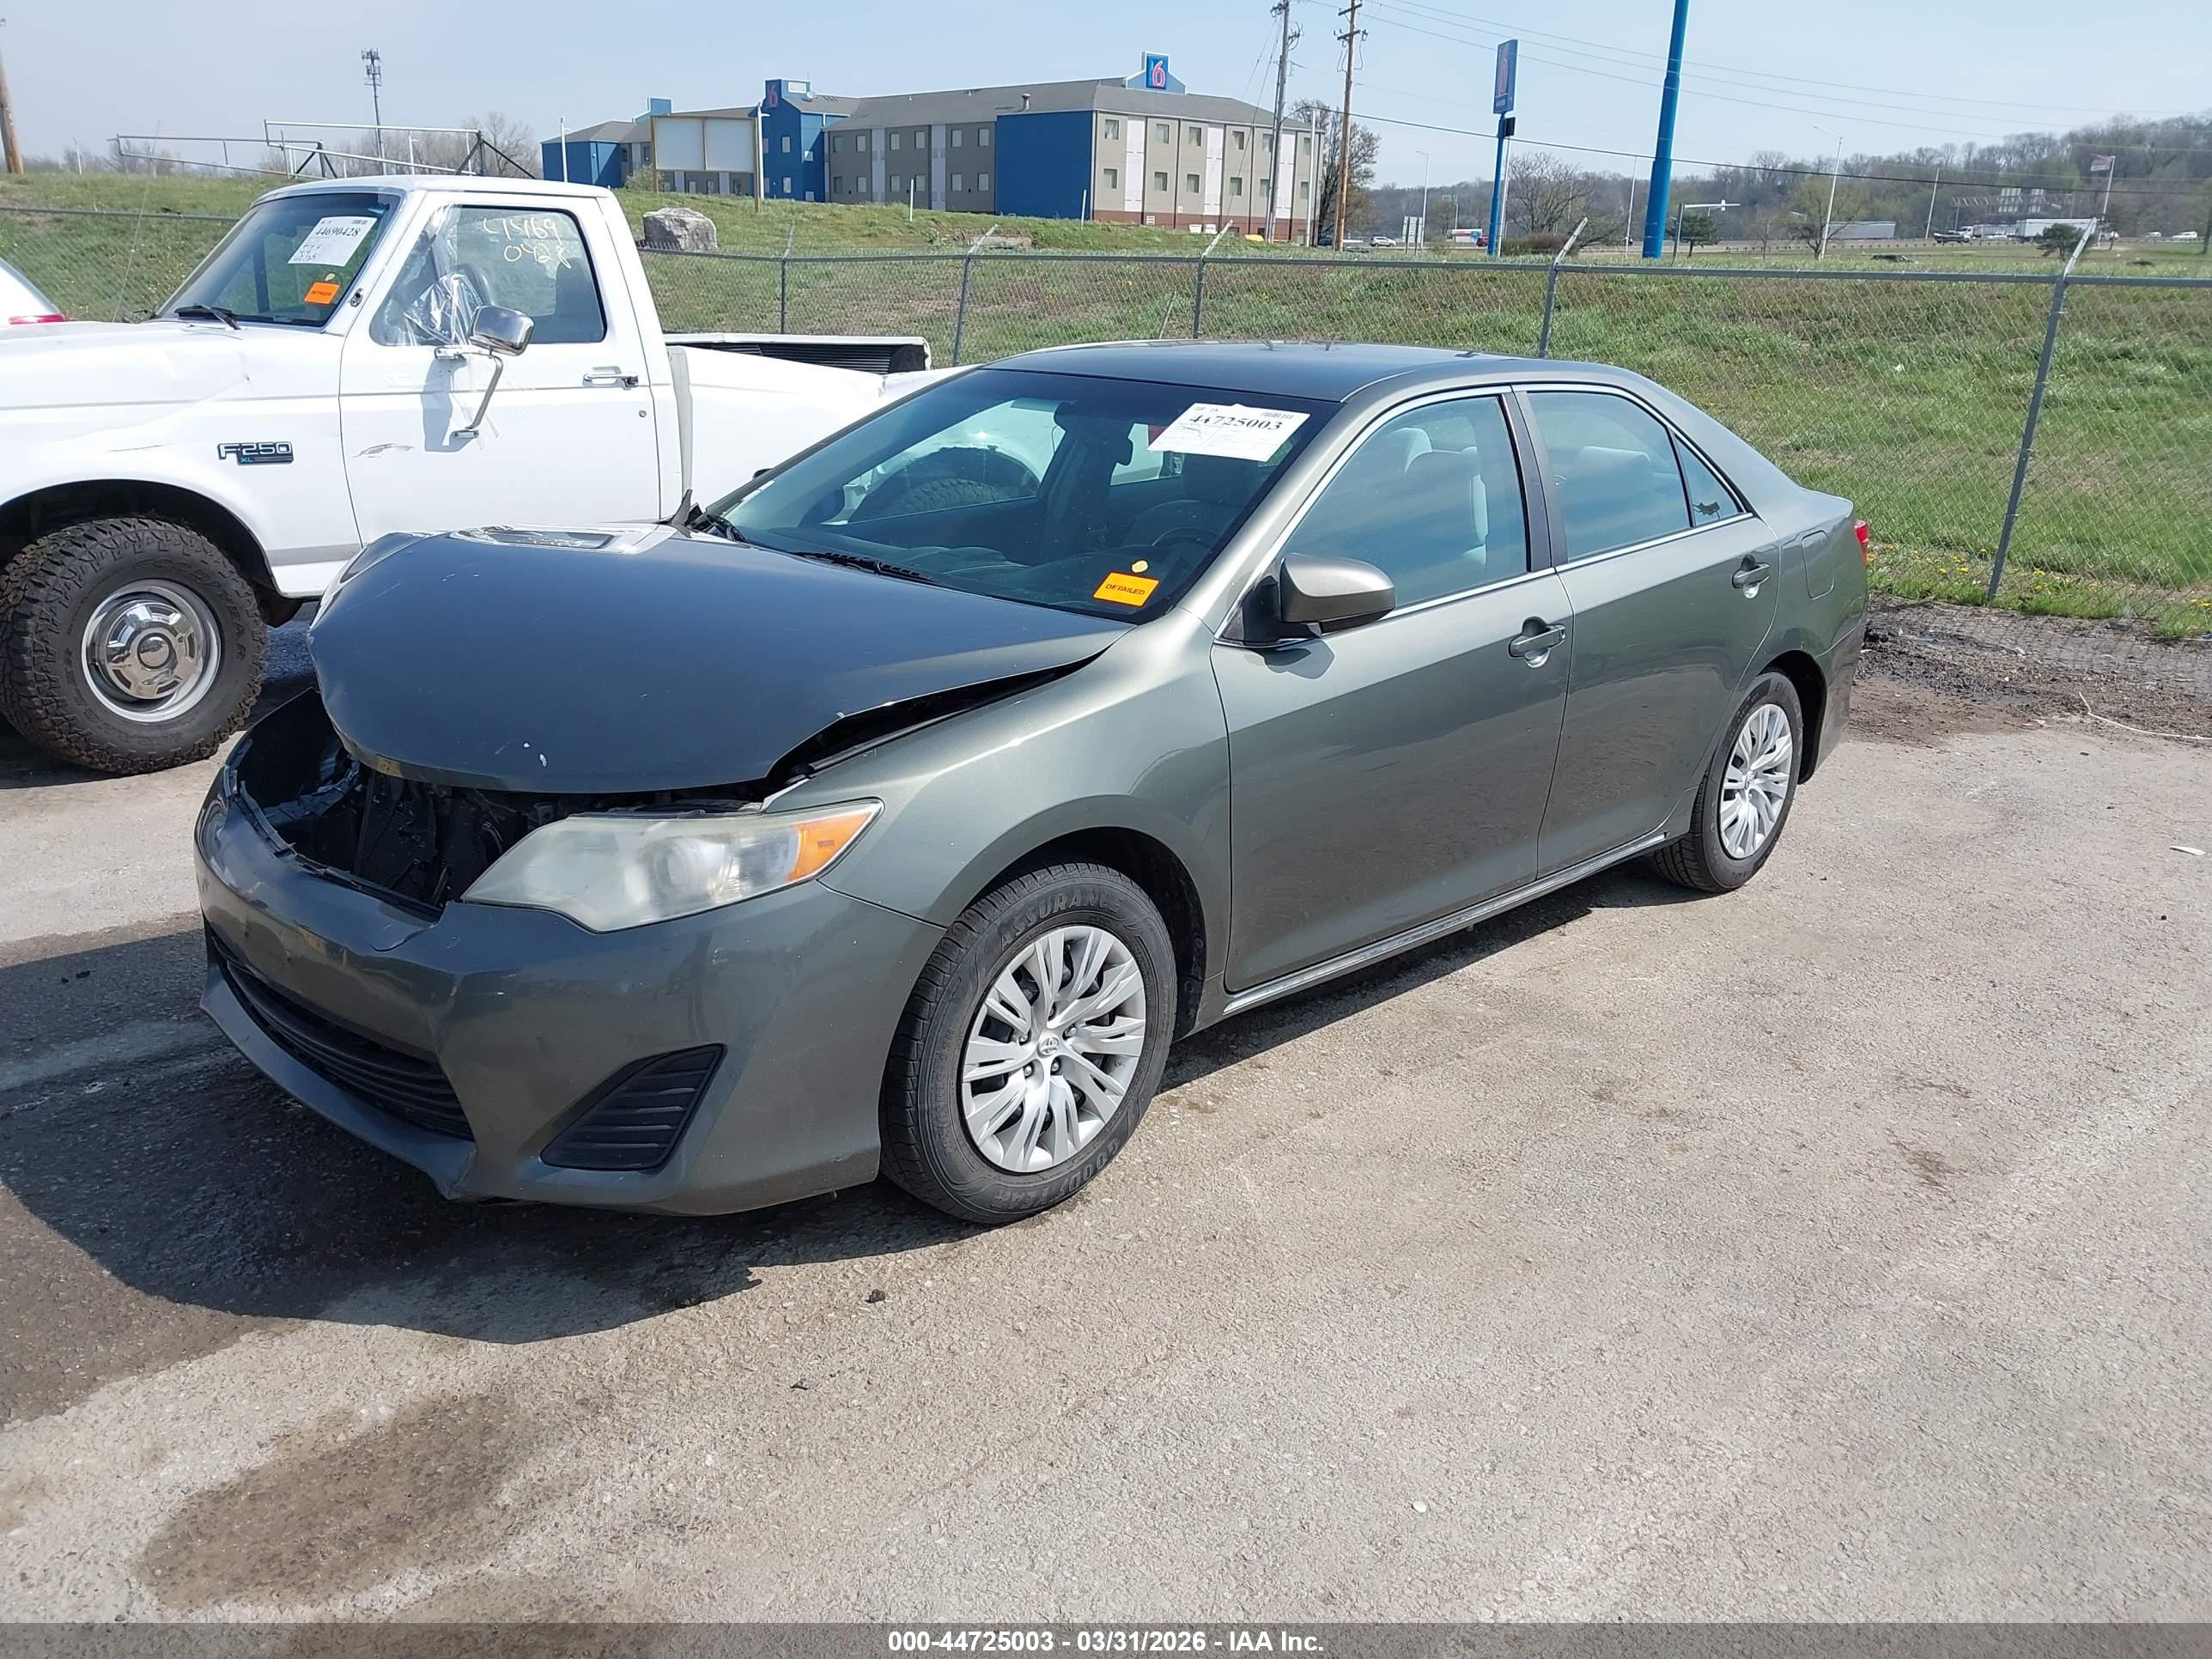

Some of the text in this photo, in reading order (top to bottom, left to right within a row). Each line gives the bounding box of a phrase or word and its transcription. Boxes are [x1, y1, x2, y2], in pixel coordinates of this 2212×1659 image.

[1152, 60, 1165, 88] 6
[315, 227, 361, 237] 44690428
[1188, 413, 1284, 431] 44725003
[1105, 583, 1146, 596] DETAILED
[1000, 890, 1124, 952] ASSURANCE
